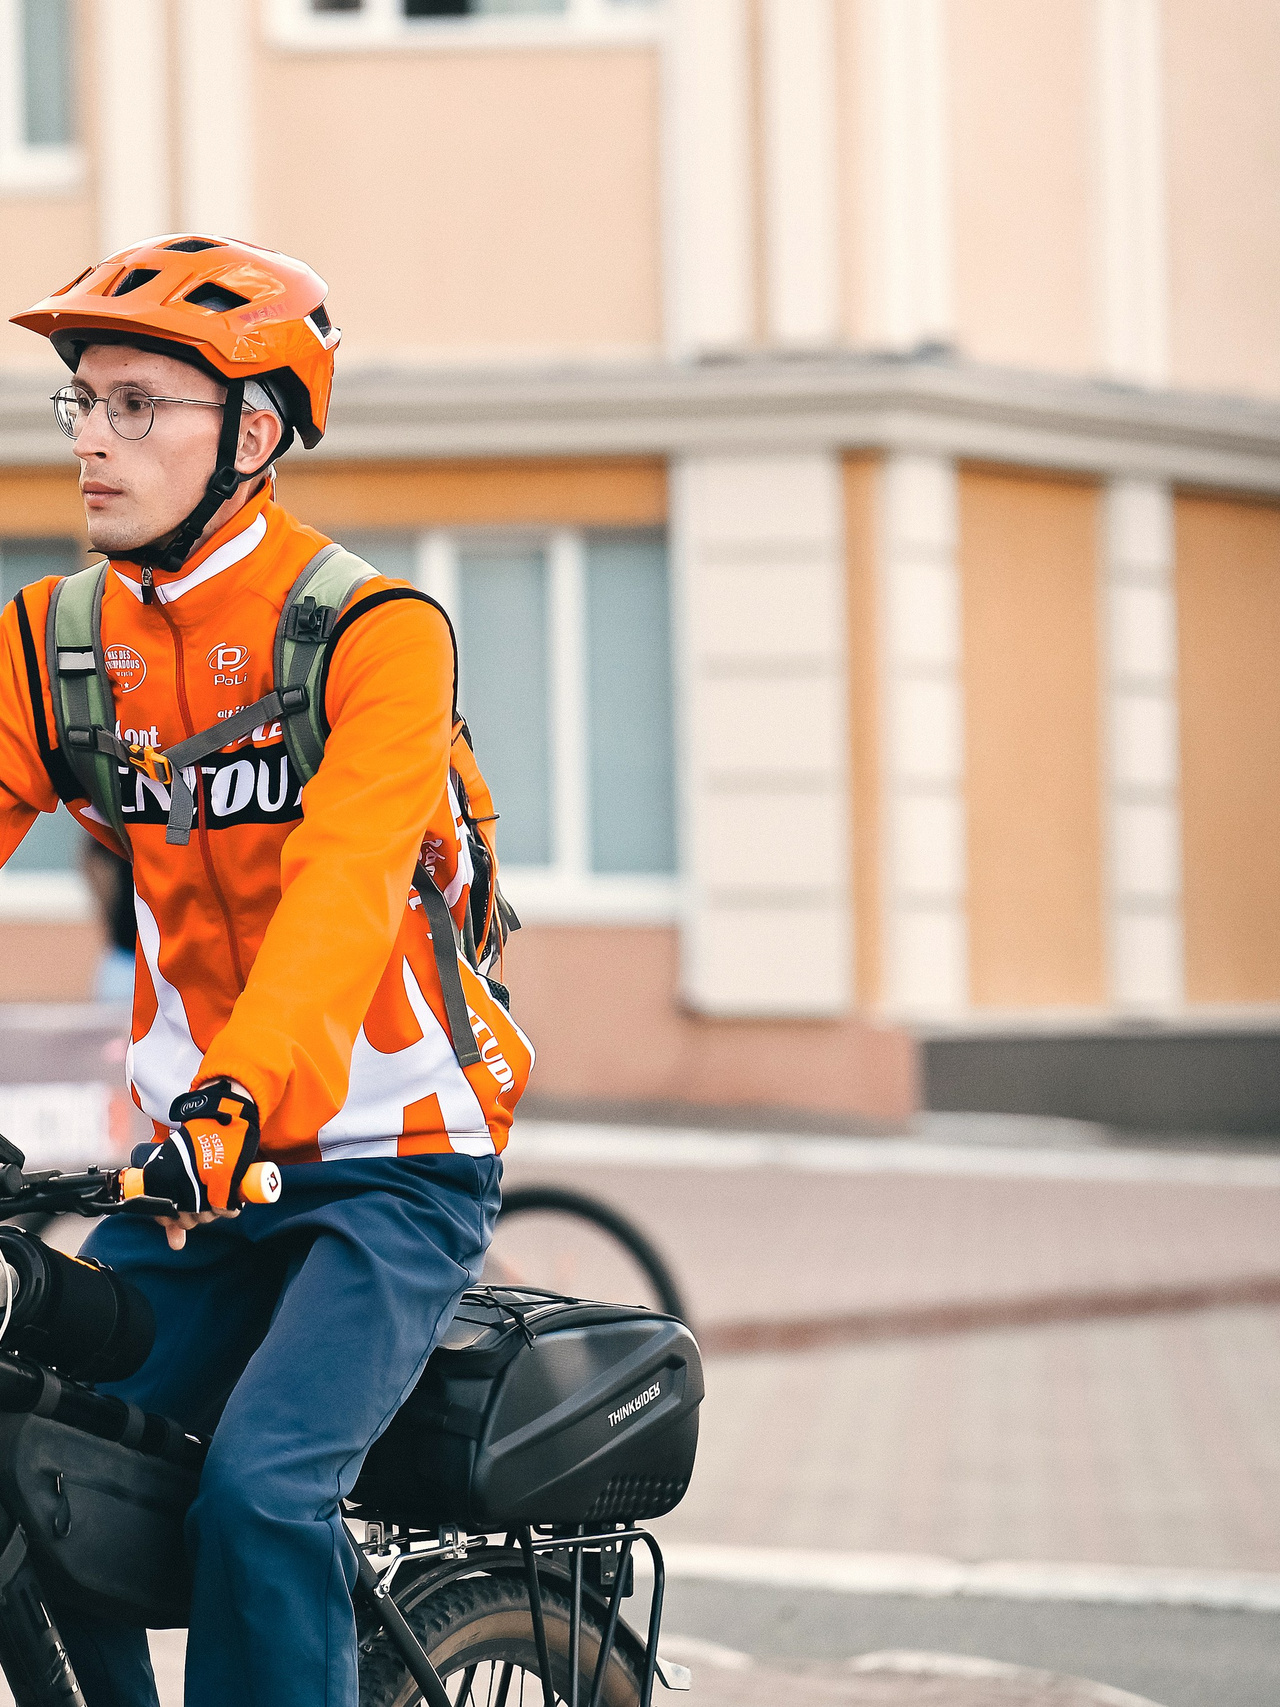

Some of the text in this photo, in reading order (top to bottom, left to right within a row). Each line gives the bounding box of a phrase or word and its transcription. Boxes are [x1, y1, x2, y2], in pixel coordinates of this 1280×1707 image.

[118, 650, 131, 660] DES
[197, 1133, 213, 1170] PERFECT
[209, 1133, 225, 1165] FITNESS
